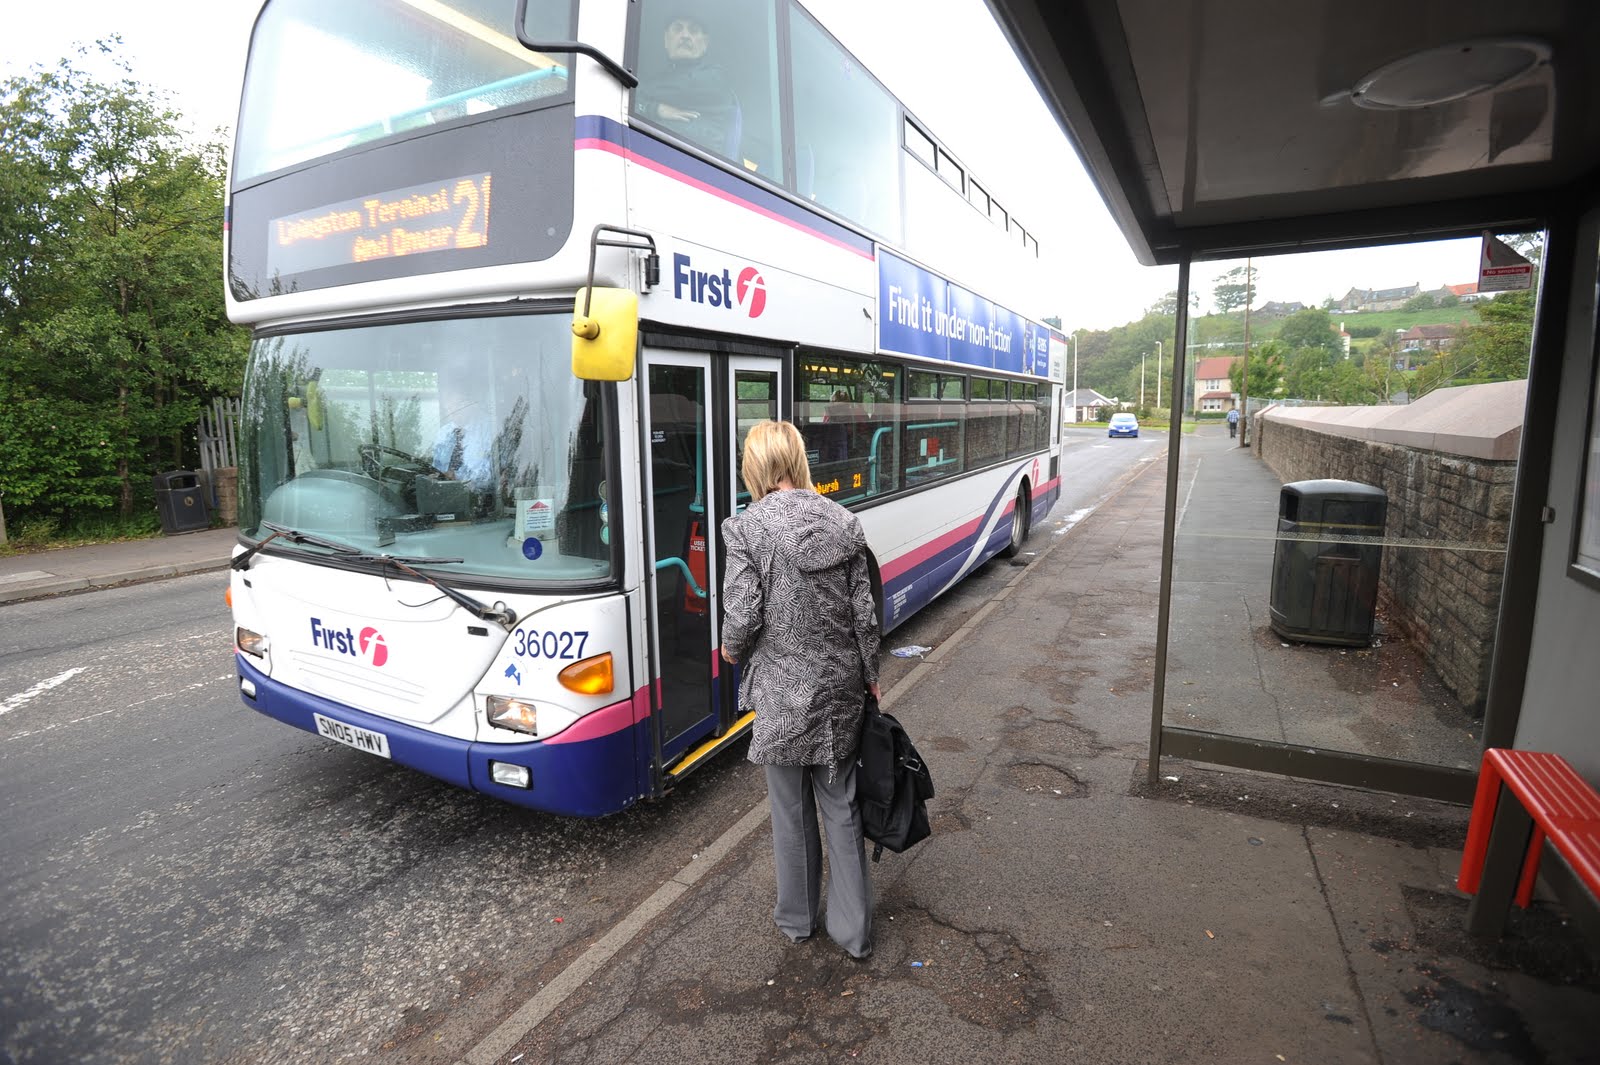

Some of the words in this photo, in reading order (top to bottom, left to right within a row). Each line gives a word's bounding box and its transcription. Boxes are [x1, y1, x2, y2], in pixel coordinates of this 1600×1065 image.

[364, 188, 449, 228] Terminal
[453, 176, 491, 248] 21
[673, 252, 732, 310] First
[889, 285, 919, 330] Find
[922, 296, 933, 333] it
[935, 307, 967, 342] under
[852, 473, 861, 488] 21
[310, 617, 357, 657] First
[514, 628, 589, 660] 36027
[319, 717, 354, 744] SN05
[354, 729, 382, 753] HWV
